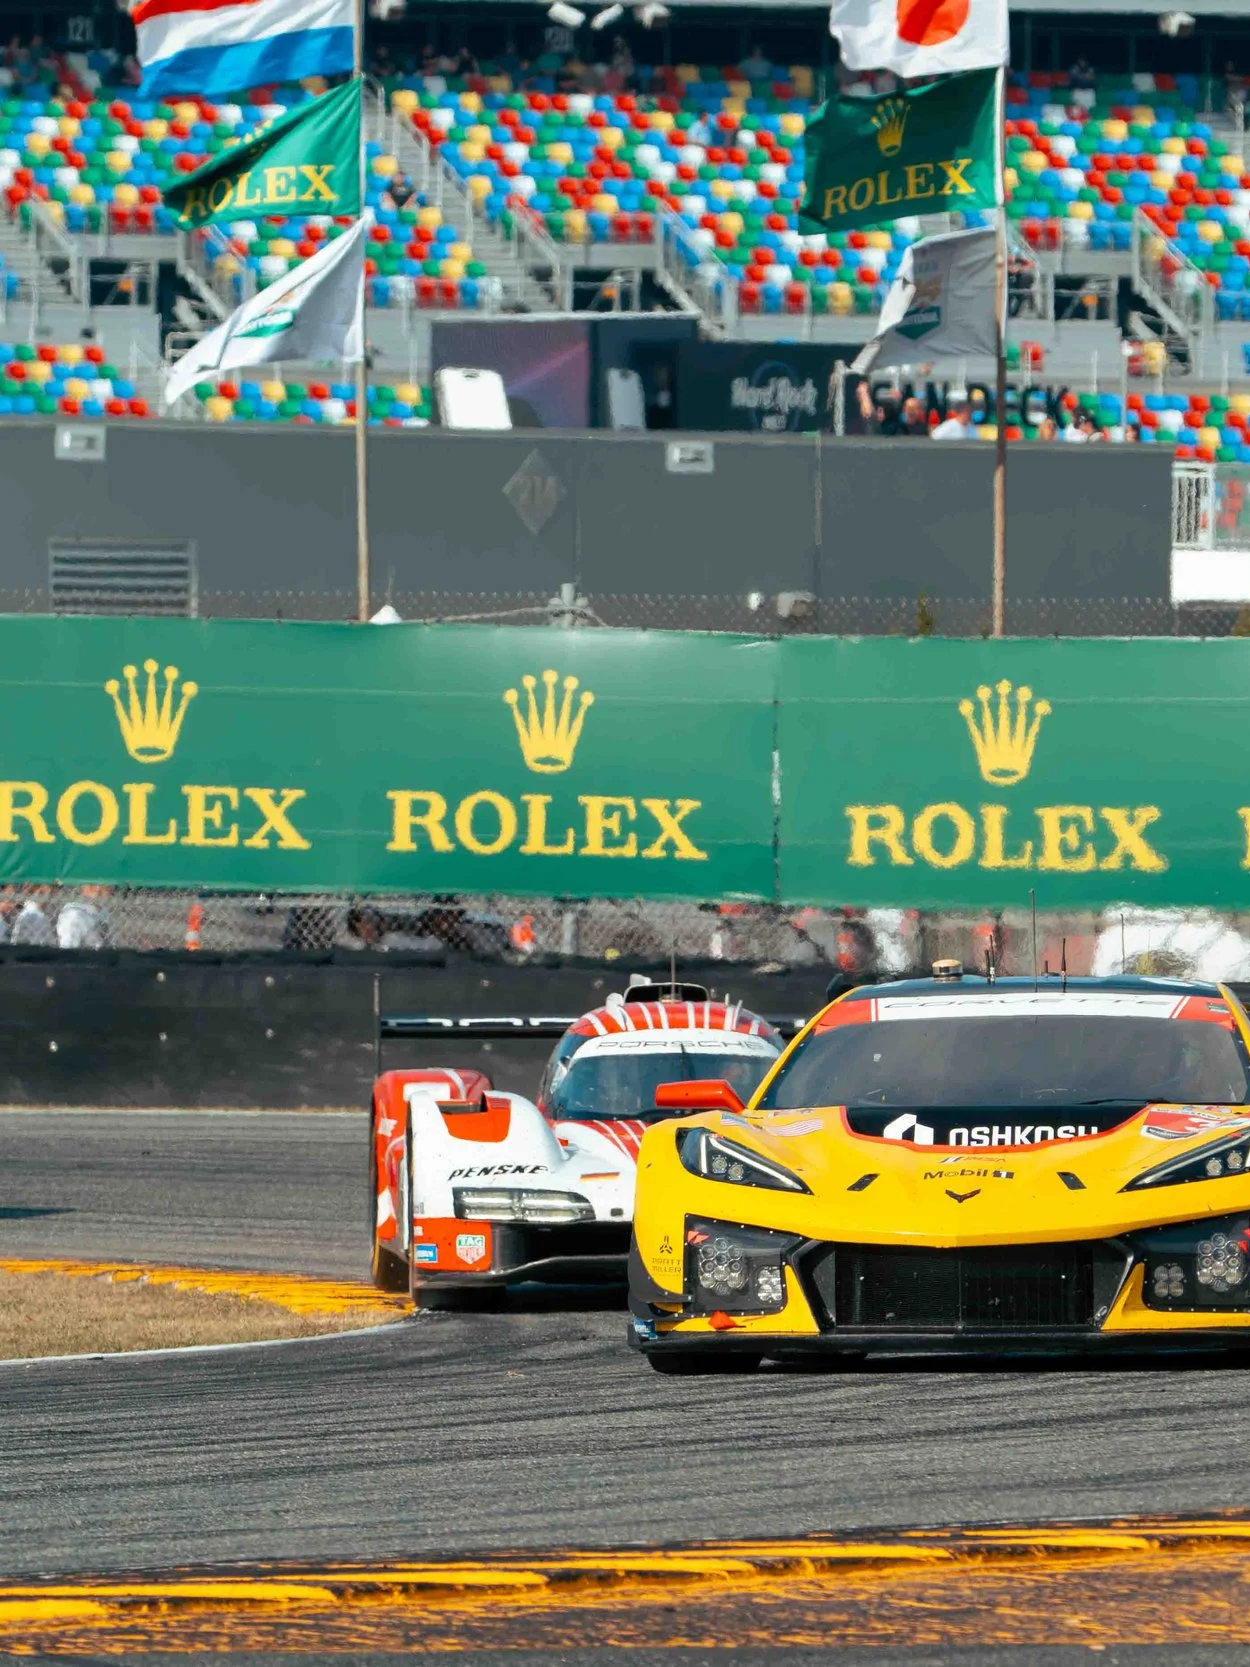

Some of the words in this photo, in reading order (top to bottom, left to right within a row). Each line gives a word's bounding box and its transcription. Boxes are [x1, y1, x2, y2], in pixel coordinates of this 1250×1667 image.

[178, 164, 340, 222] ROLEX
[821, 158, 976, 220] ROLEX
[0, 782, 310, 850] ROLEX
[387, 790, 707, 859] ROLEX
[845, 803, 1168, 872] ROLEX
[597, 1039, 766, 1050] PORSCHE
[447, 1164, 549, 1182] PENSKE
[923, 1168, 989, 1180] Mobil
[461, 1236, 483, 1247] TAG
